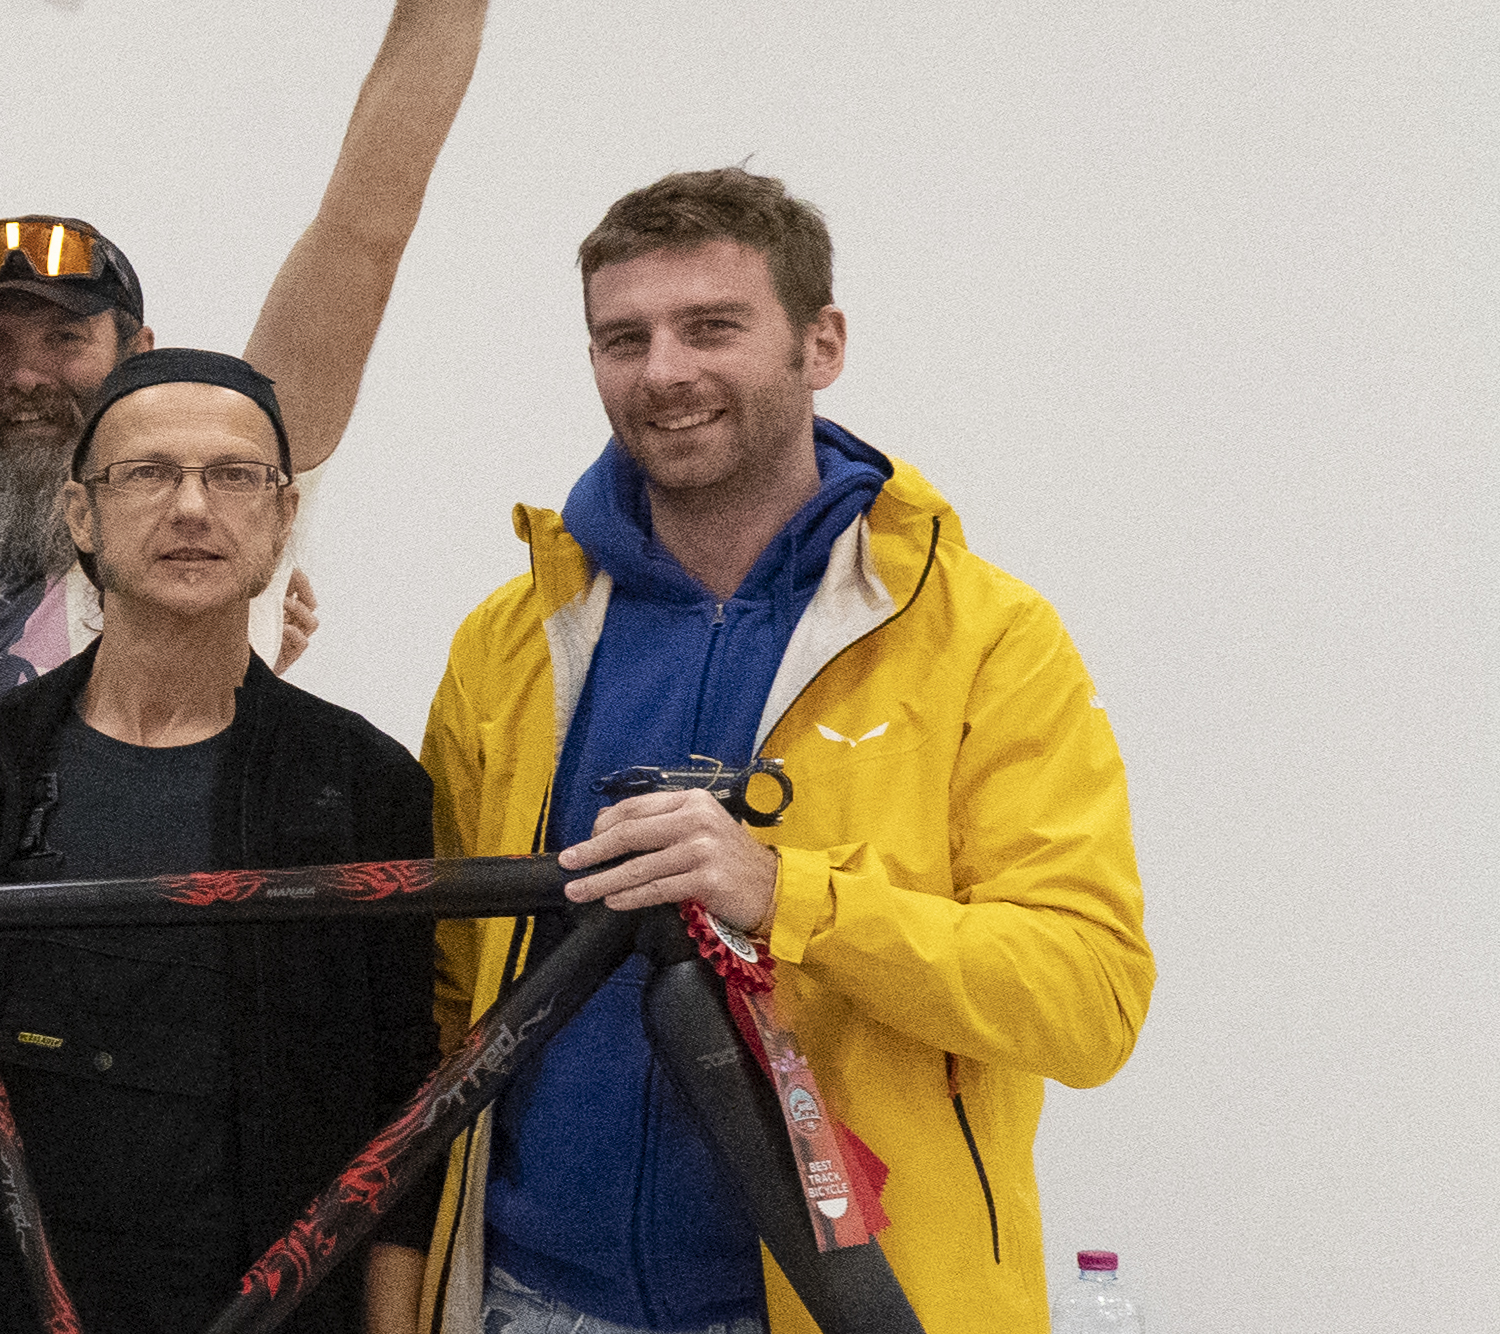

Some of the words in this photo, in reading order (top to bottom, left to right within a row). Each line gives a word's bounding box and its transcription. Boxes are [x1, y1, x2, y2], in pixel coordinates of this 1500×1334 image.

[808, 1160, 831, 1172] BEST
[808, 1172, 841, 1184] TRACK
[808, 1183, 849, 1198] BICYCLE
